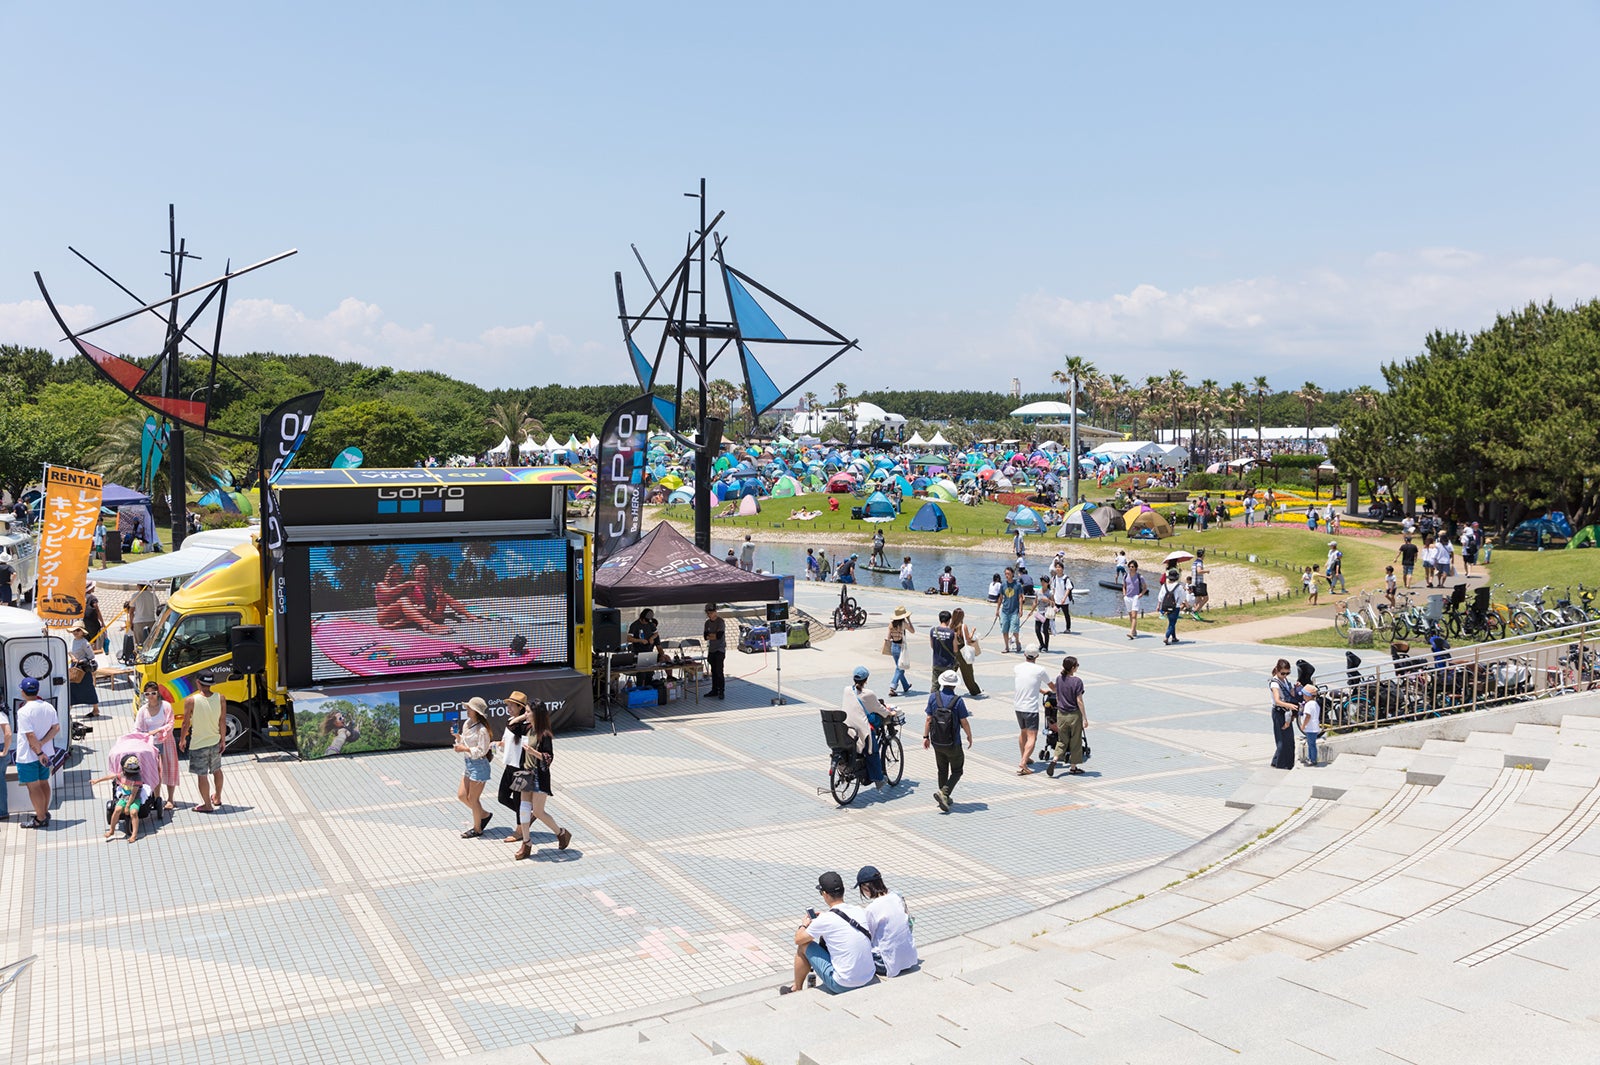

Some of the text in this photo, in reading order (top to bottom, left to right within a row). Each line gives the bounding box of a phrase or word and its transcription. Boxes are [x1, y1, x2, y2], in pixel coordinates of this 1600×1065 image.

[51, 471, 101, 487] RENTAL
[608, 413, 634, 538] GoPro
[377, 487, 465, 499] GoPro
[630, 487, 640, 516] HERO.
[67, 490, 99, 540] レンタル
[630, 522, 638, 533] Be
[42, 496, 72, 600] キャンピングカー
[646, 557, 703, 576] GoPro
[277, 576, 285, 614] GoPro
[544, 700, 566, 711] TRY
